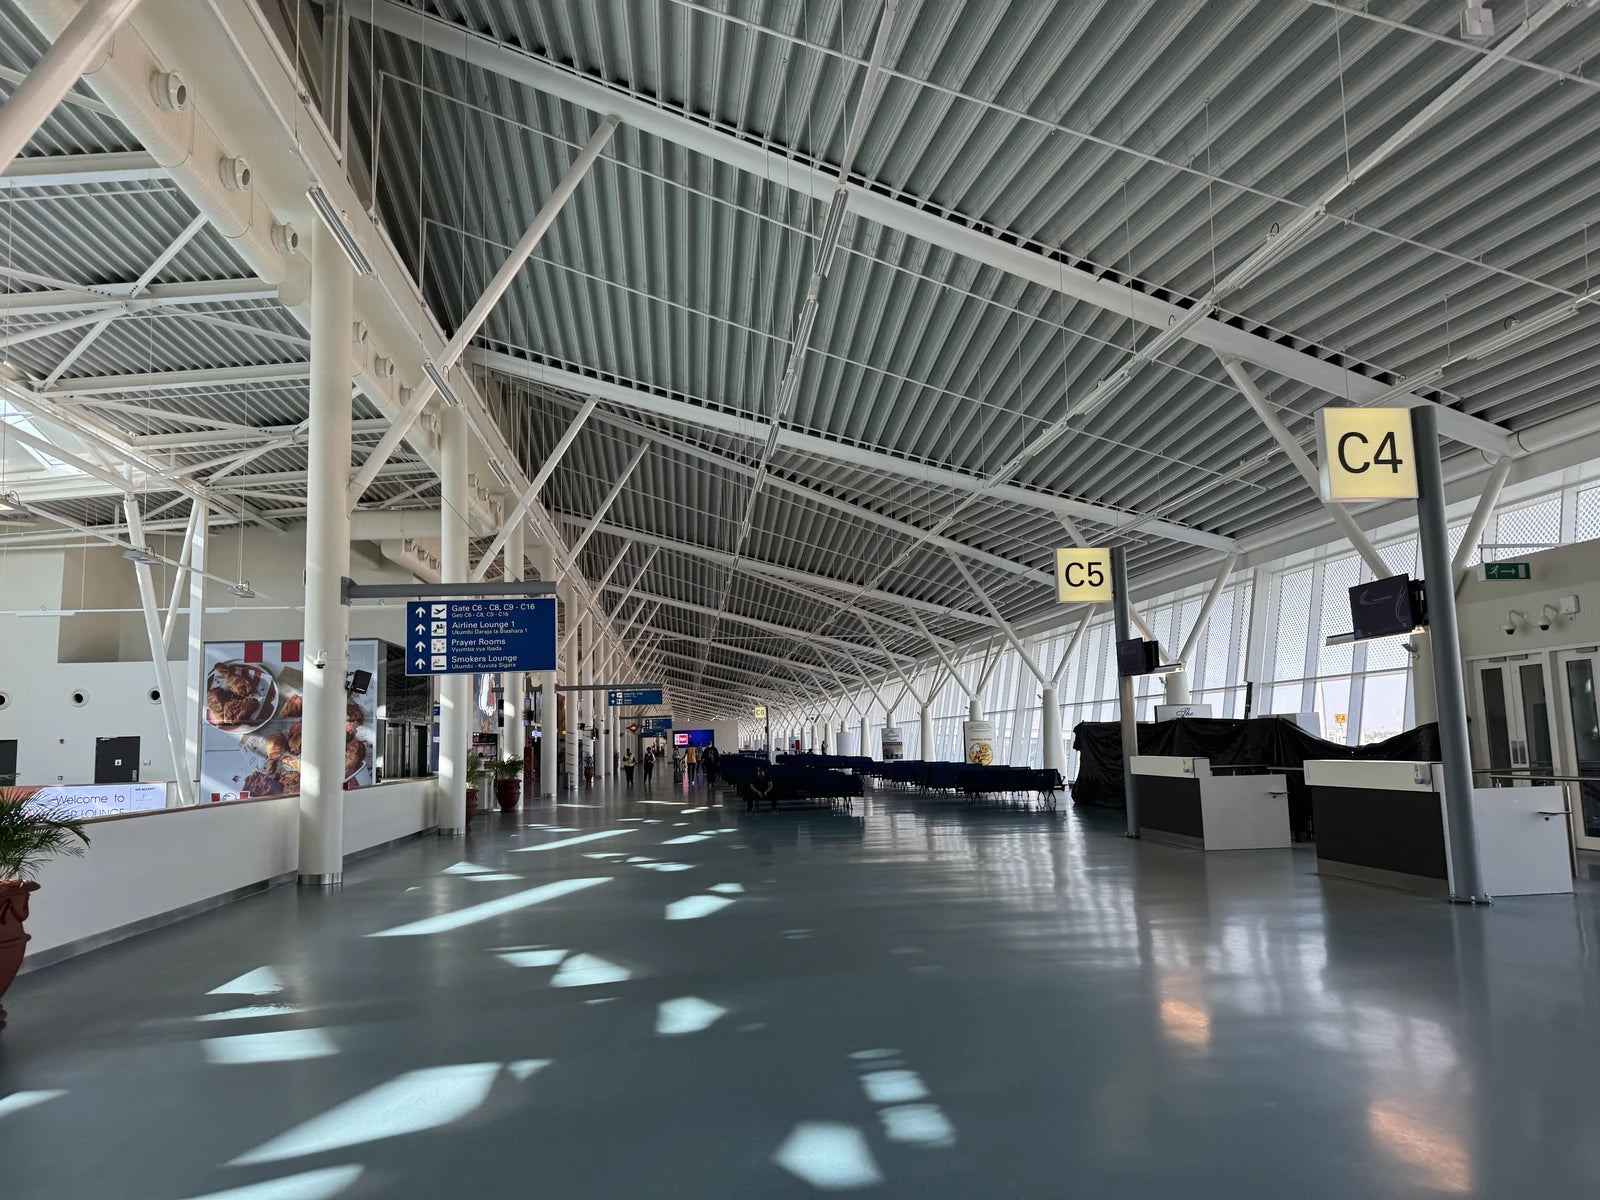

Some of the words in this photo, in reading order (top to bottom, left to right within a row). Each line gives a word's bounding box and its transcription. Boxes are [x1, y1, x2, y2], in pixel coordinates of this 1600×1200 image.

[1338, 432, 1403, 474] C4
[1065, 562, 1104, 587] C5
[451, 604, 470, 612] Gate
[489, 604, 501, 612] C8,
[503, 603, 514, 611] C9
[520, 603, 536, 611] C16
[451, 621, 478, 629] Airline
[480, 621, 509, 630] Lounge
[451, 639, 477, 647] Prayer
[451, 655, 487, 663] Smokers
[488, 655, 518, 663] Lounge
[56, 794, 108, 805] Welcome
[114, 794, 125, 803] to
